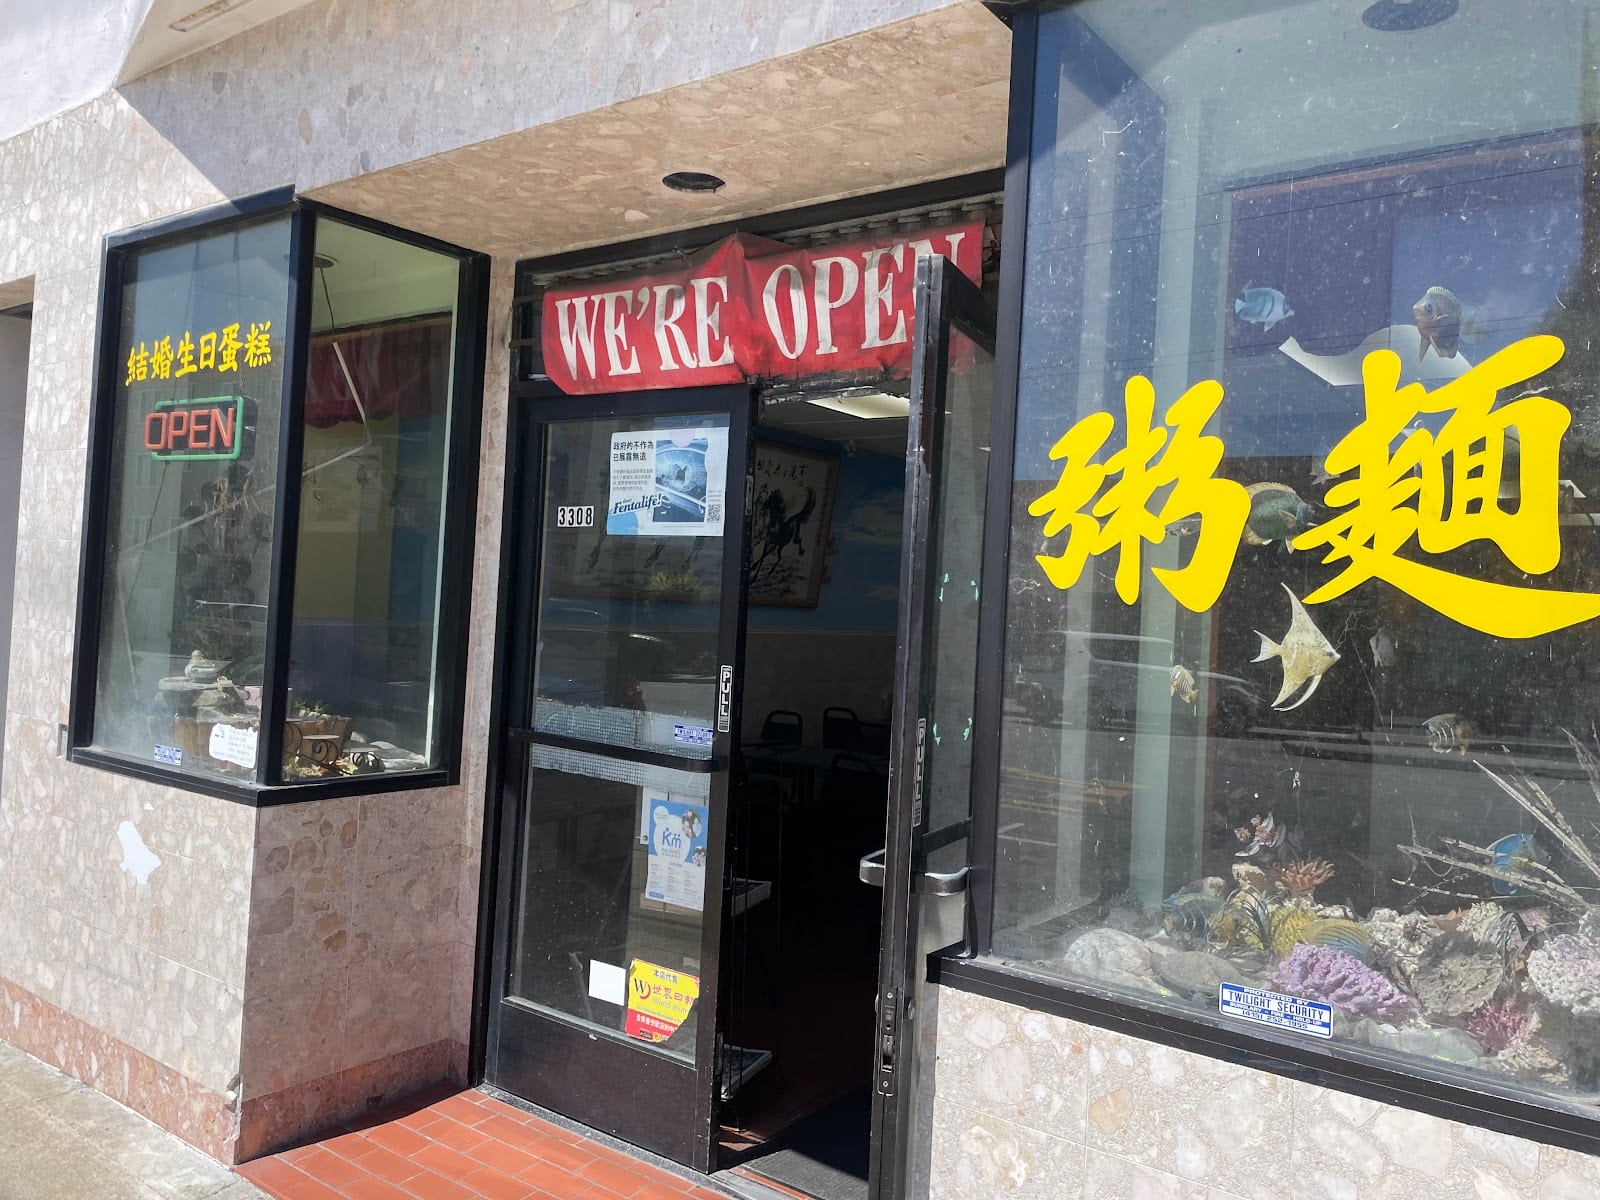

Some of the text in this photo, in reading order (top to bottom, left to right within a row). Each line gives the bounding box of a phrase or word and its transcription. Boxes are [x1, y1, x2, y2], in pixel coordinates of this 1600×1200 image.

[555, 276, 735, 381] WE'RE
[124, 320, 272, 387] 結婚生日蛋糕
[144, 407, 235, 450] OPEN
[559, 507, 593, 526] 3308
[612, 493, 662, 515] Fentalife!
[720, 671, 731, 716] PULL
[1228, 990, 1324, 1020] TWILIGHT SECURITY
[1244, 988, 1293, 1002] PROTECTED
